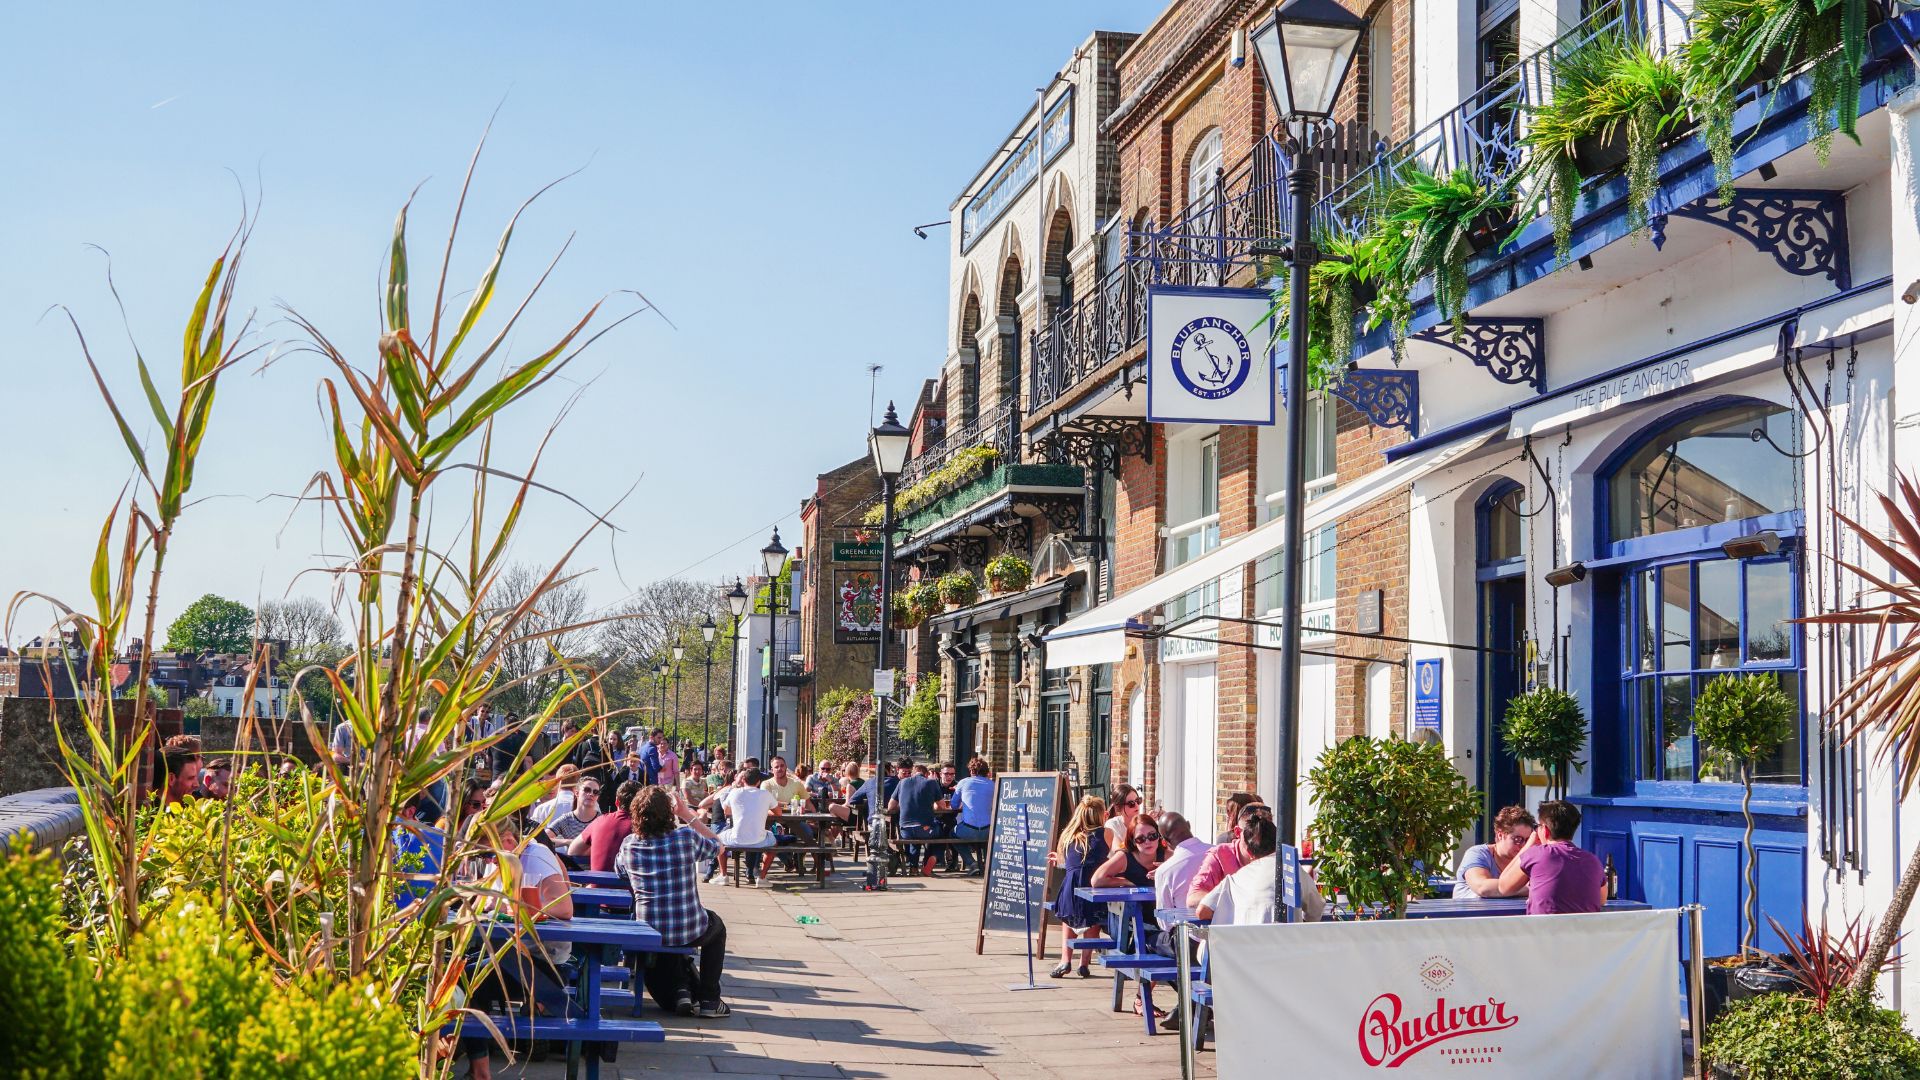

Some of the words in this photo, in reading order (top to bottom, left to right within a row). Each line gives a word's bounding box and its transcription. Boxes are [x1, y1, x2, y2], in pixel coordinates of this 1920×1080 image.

[1172, 322, 1196, 358] BLUE
[1201, 318, 1250, 360] ANCHOR
[1213, 387, 1232, 398] 1722
[1574, 389, 1595, 410] THE
[1600, 377, 1629, 403] BLUE
[1632, 359, 1689, 393] ANCHOR
[1308, 614, 1331, 637] CLUB
[1186, 633, 1217, 654] KENSINGT
[1002, 780, 1019, 799] Blue
[1022, 779, 1048, 798] Anchor
[1026, 803, 1050, 816] cktails
[1427, 968, 1447, 979] 1895
[1358, 993, 1519, 1067] Budvar
[1440, 1047, 1502, 1055] BUDWEISER
[1451, 1056, 1492, 1064] BUDVAR
